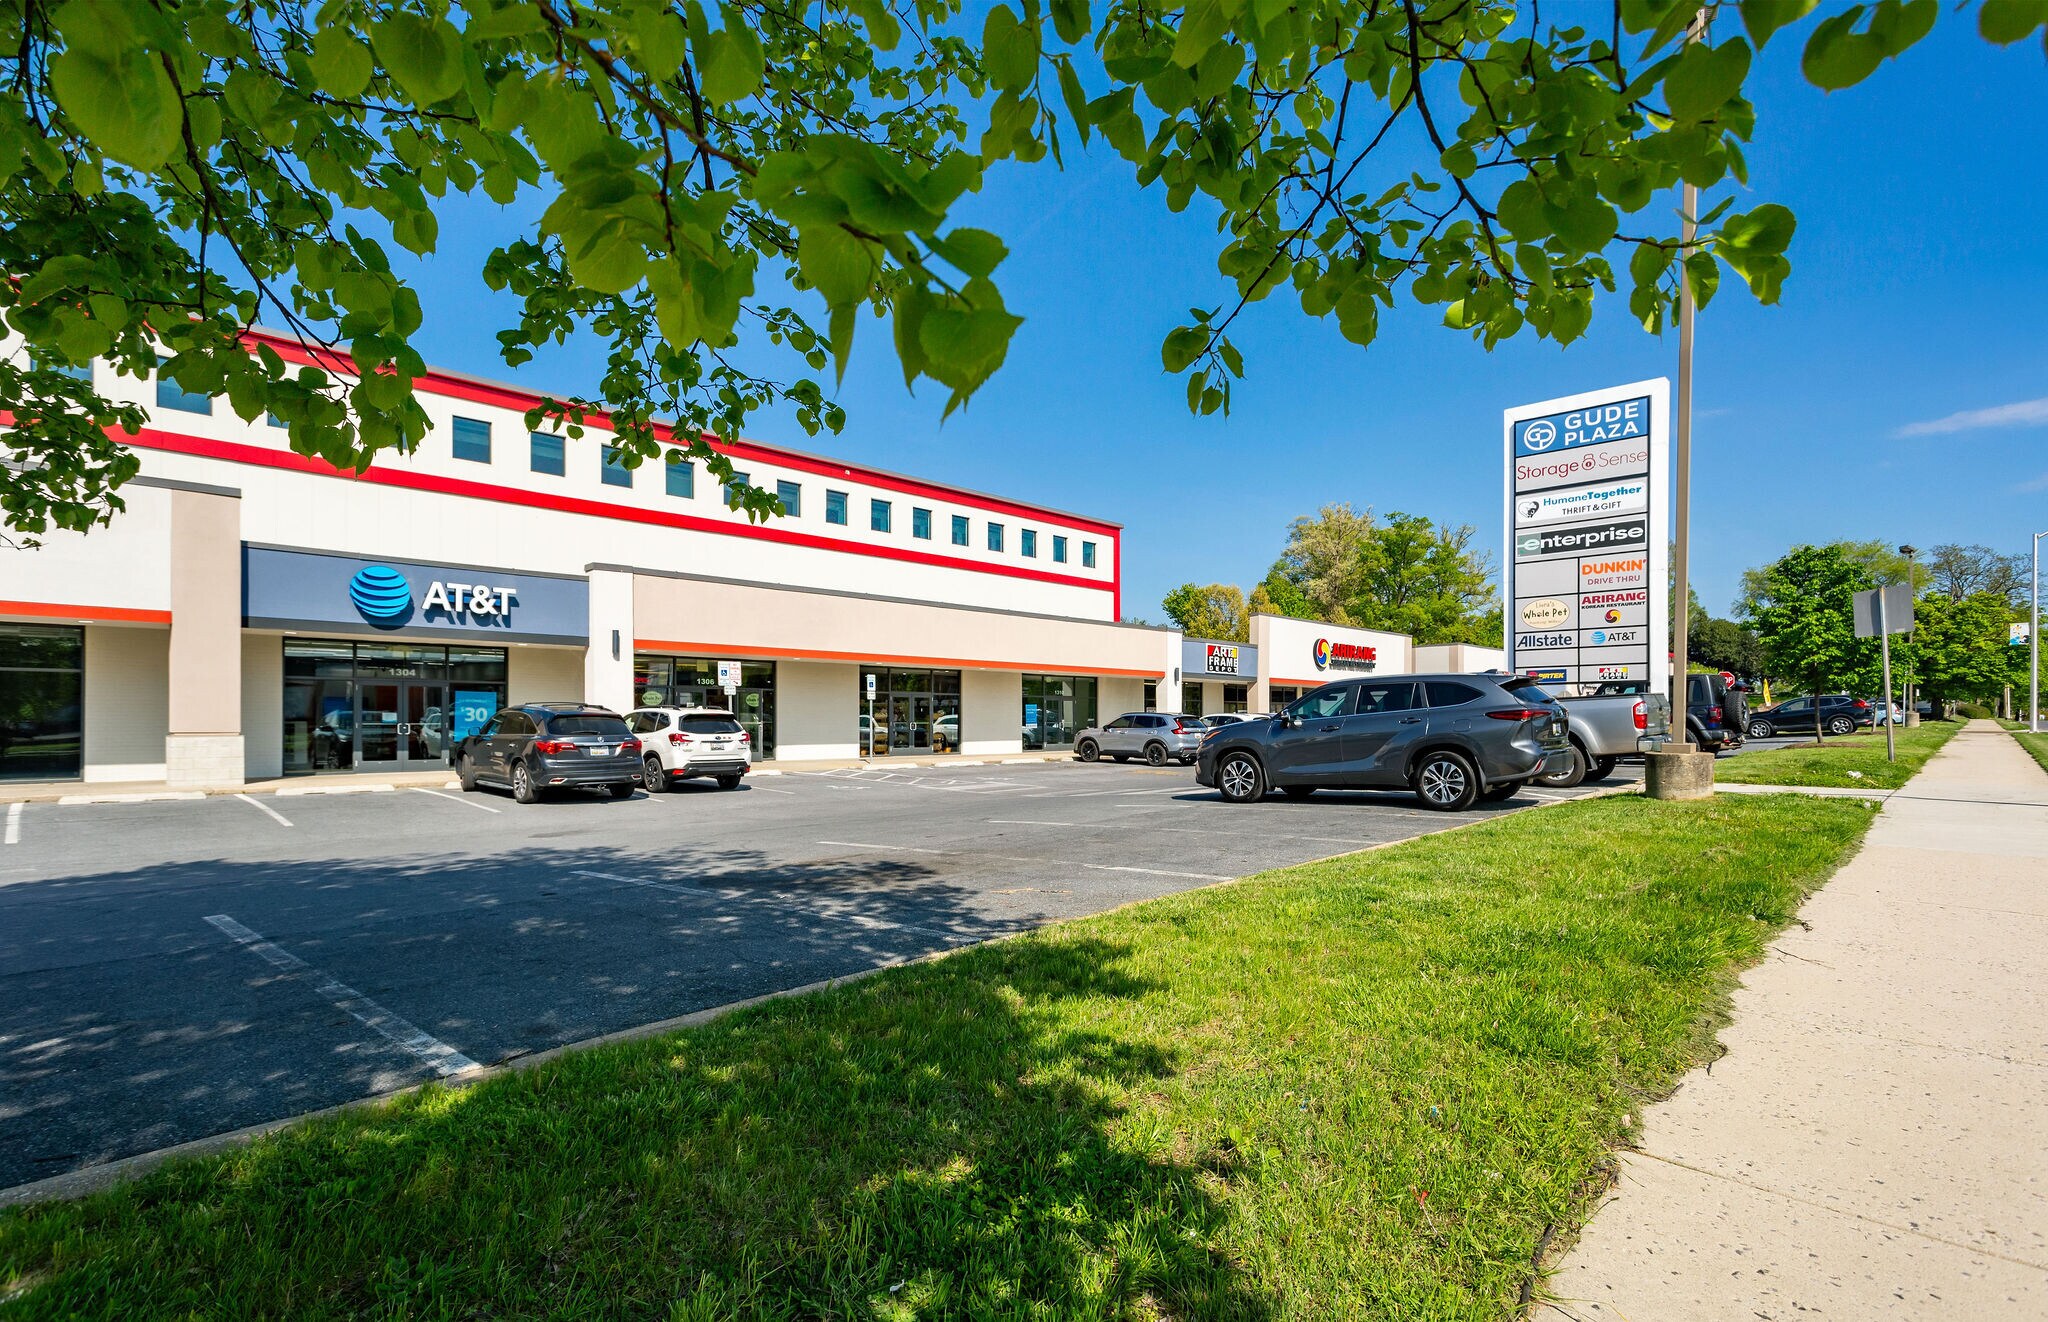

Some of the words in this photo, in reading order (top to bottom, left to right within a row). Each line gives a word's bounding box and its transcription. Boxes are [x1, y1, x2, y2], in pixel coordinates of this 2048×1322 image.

[1564, 402, 1639, 430] GUDE
[1564, 421, 1639, 446] PLAZA
[1517, 461, 1579, 480] Storage
[1598, 451, 1648, 468] Sense
[1543, 485, 1642, 507] HumaneTogether
[1562, 504, 1591, 515] THRIFT
[1592, 503, 1600, 511] &
[1601, 501, 1622, 510] GIFT
[1522, 527, 1644, 551] enterprise
[1581, 559, 1647, 576] DUNKIN'
[1587, 577, 1614, 586] DRIVE
[1616, 575, 1641, 583] THRU
[421, 581, 517, 616] AT&T
[1581, 591, 1646, 605] ARIRANG
[1523, 609, 1550, 619] Whole
[1552, 608, 1568, 618] Pet
[1517, 633, 1573, 648] Allstate
[1608, 631, 1637, 642] AT&T
[1209, 656, 1238, 667] FRAME
[389, 668, 416, 677] 1304
